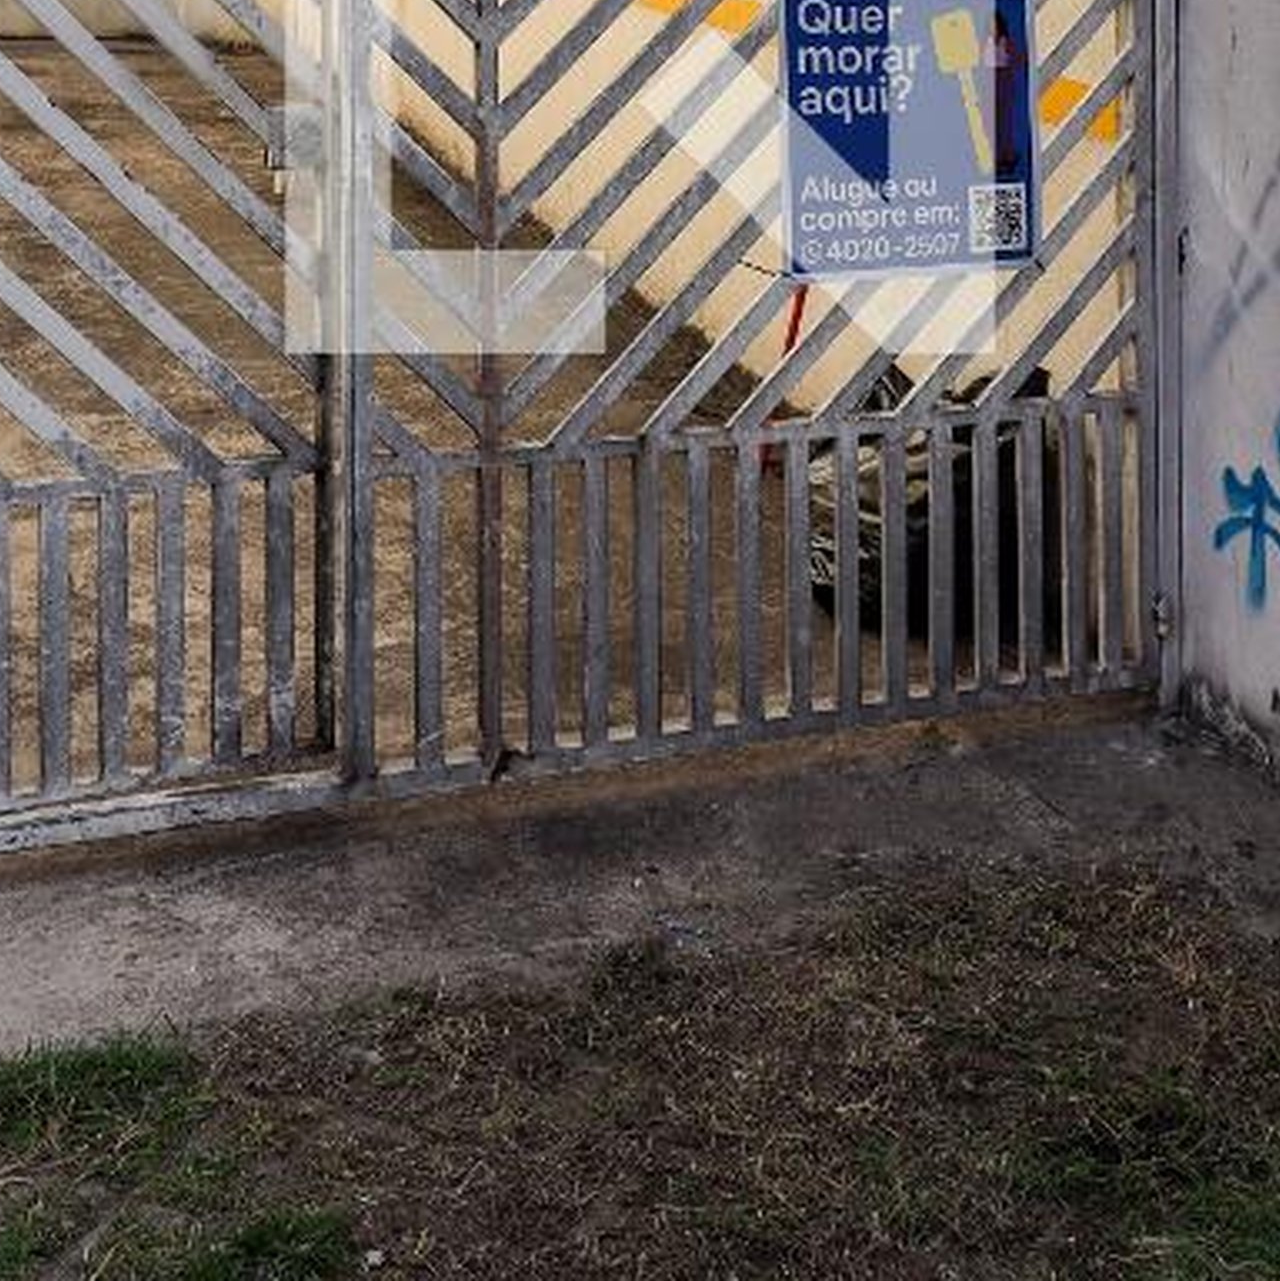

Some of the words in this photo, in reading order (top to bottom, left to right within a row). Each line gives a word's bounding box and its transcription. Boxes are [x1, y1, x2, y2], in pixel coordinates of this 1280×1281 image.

[797, 44, 921, 75] morar
[799, 74, 914, 124] aqui?
[801, 175, 898, 207] Alugue
[903, 176, 937, 198] ou
[800, 207, 907, 233] compre
[914, 202, 961, 225] em:
[826, 232, 961, 262] 4020-2507
